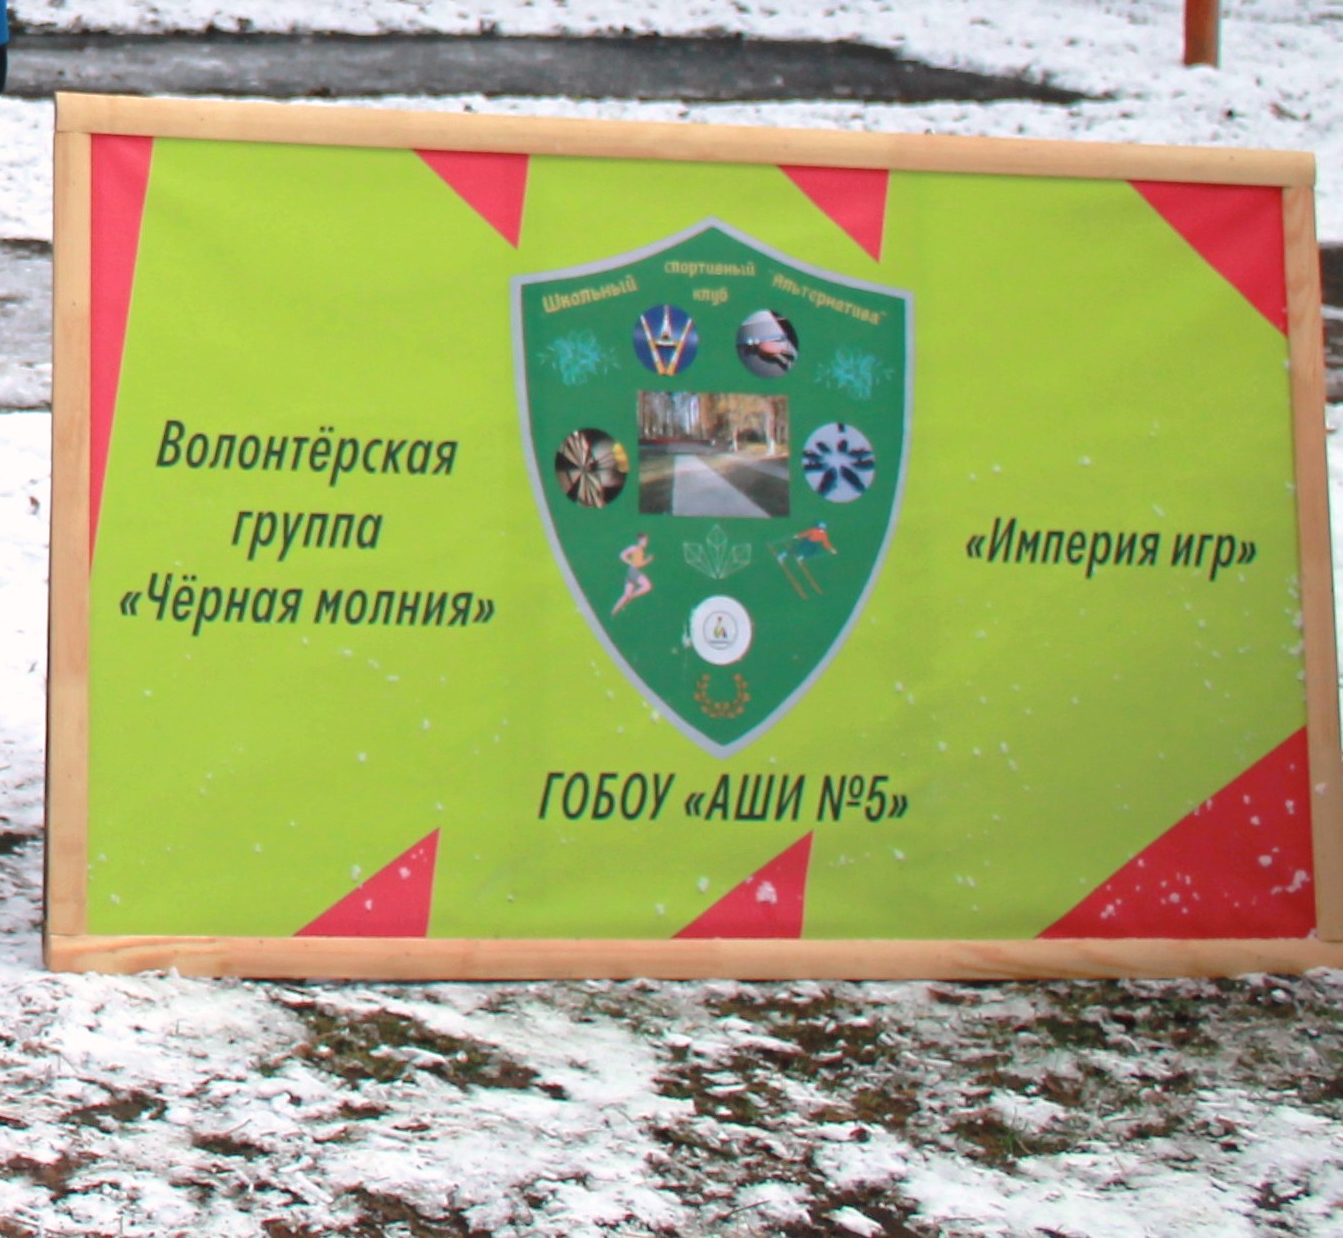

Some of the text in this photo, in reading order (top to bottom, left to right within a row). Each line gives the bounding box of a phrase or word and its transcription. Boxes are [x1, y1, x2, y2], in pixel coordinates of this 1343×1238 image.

[542, 274, 638, 314] Школьный
[692, 287, 729, 306] клуб
[156, 419, 458, 487] Волонтёрская
[231, 510, 383, 561] группа
[966, 516, 1257, 582] «Империя игр»
[120, 572, 496, 637] «Чёрная молния»
[538, 772, 908, 823] ГОБОУ «АШИ №5»
